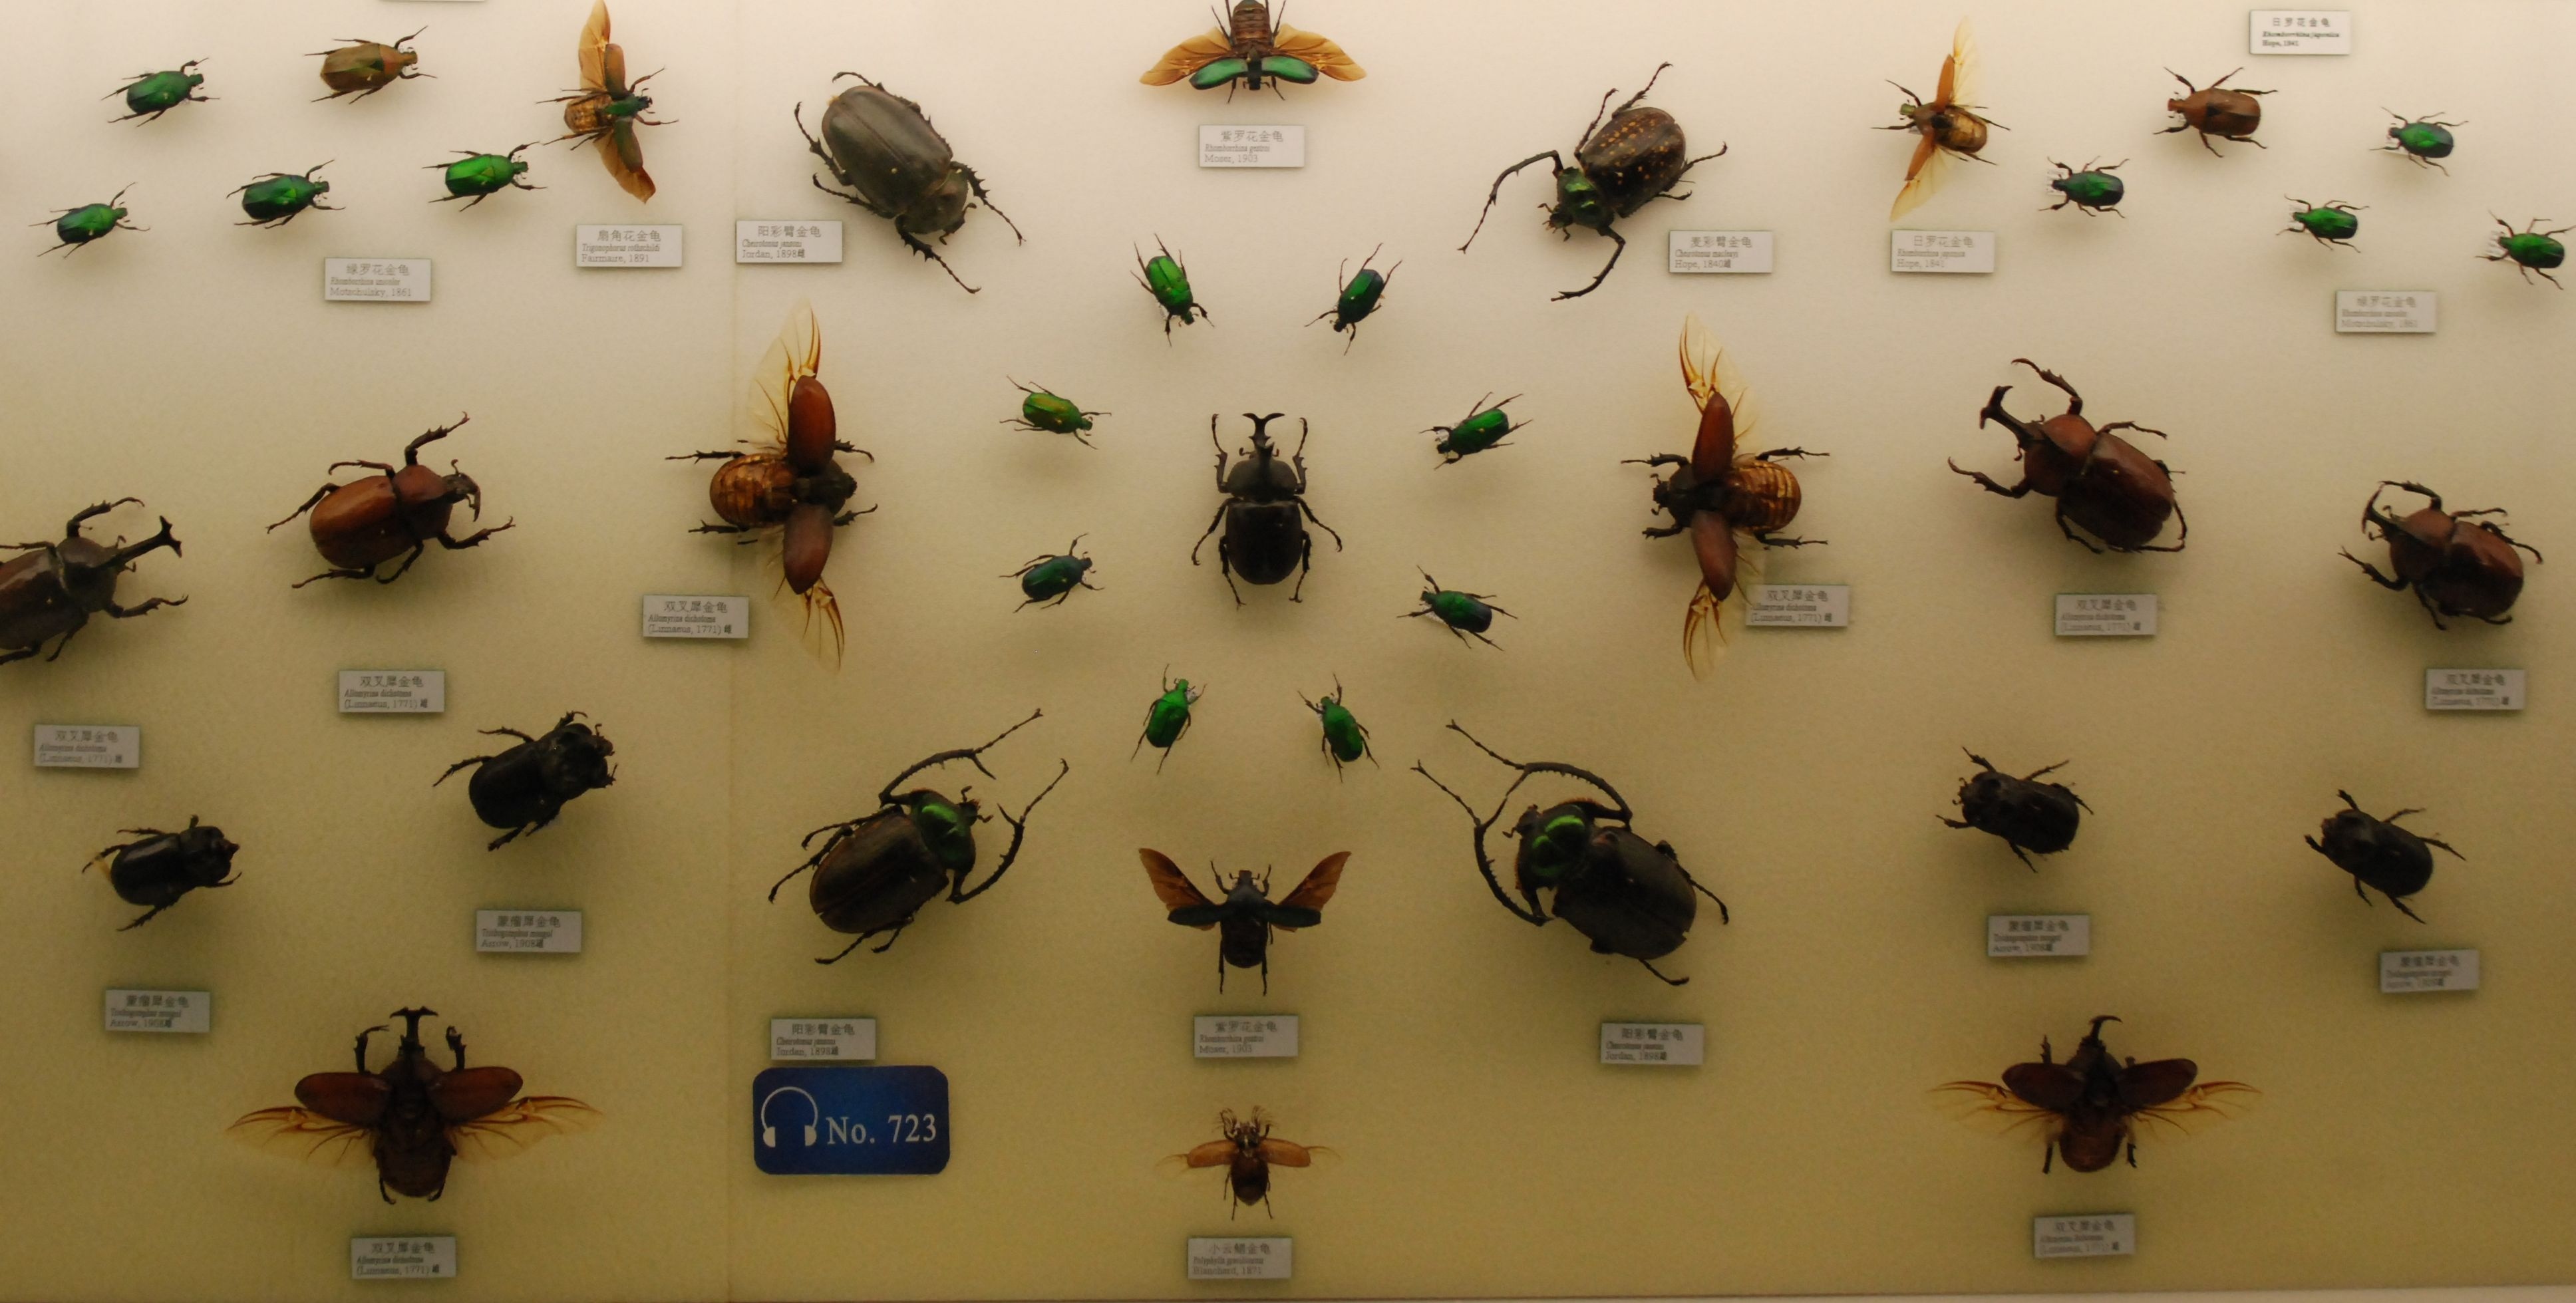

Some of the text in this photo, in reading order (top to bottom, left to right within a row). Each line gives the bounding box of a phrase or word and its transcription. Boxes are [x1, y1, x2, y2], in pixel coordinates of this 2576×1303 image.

[1219, 130, 1283, 142] 紫罗花金龟
[758, 225, 821, 237] 阳彩臂金龟
[1914, 235, 1973, 248] 日罗花金龟
[629, 253, 649, 262] 1891
[742, 249, 773, 259] Jordan,
[1675, 259, 1700, 270] Hope,
[665, 601, 727, 613] 双叉犀金龟
[360, 675, 424, 688] 双叉犀金龟
[826, 1113, 937, 1145] No. 723
